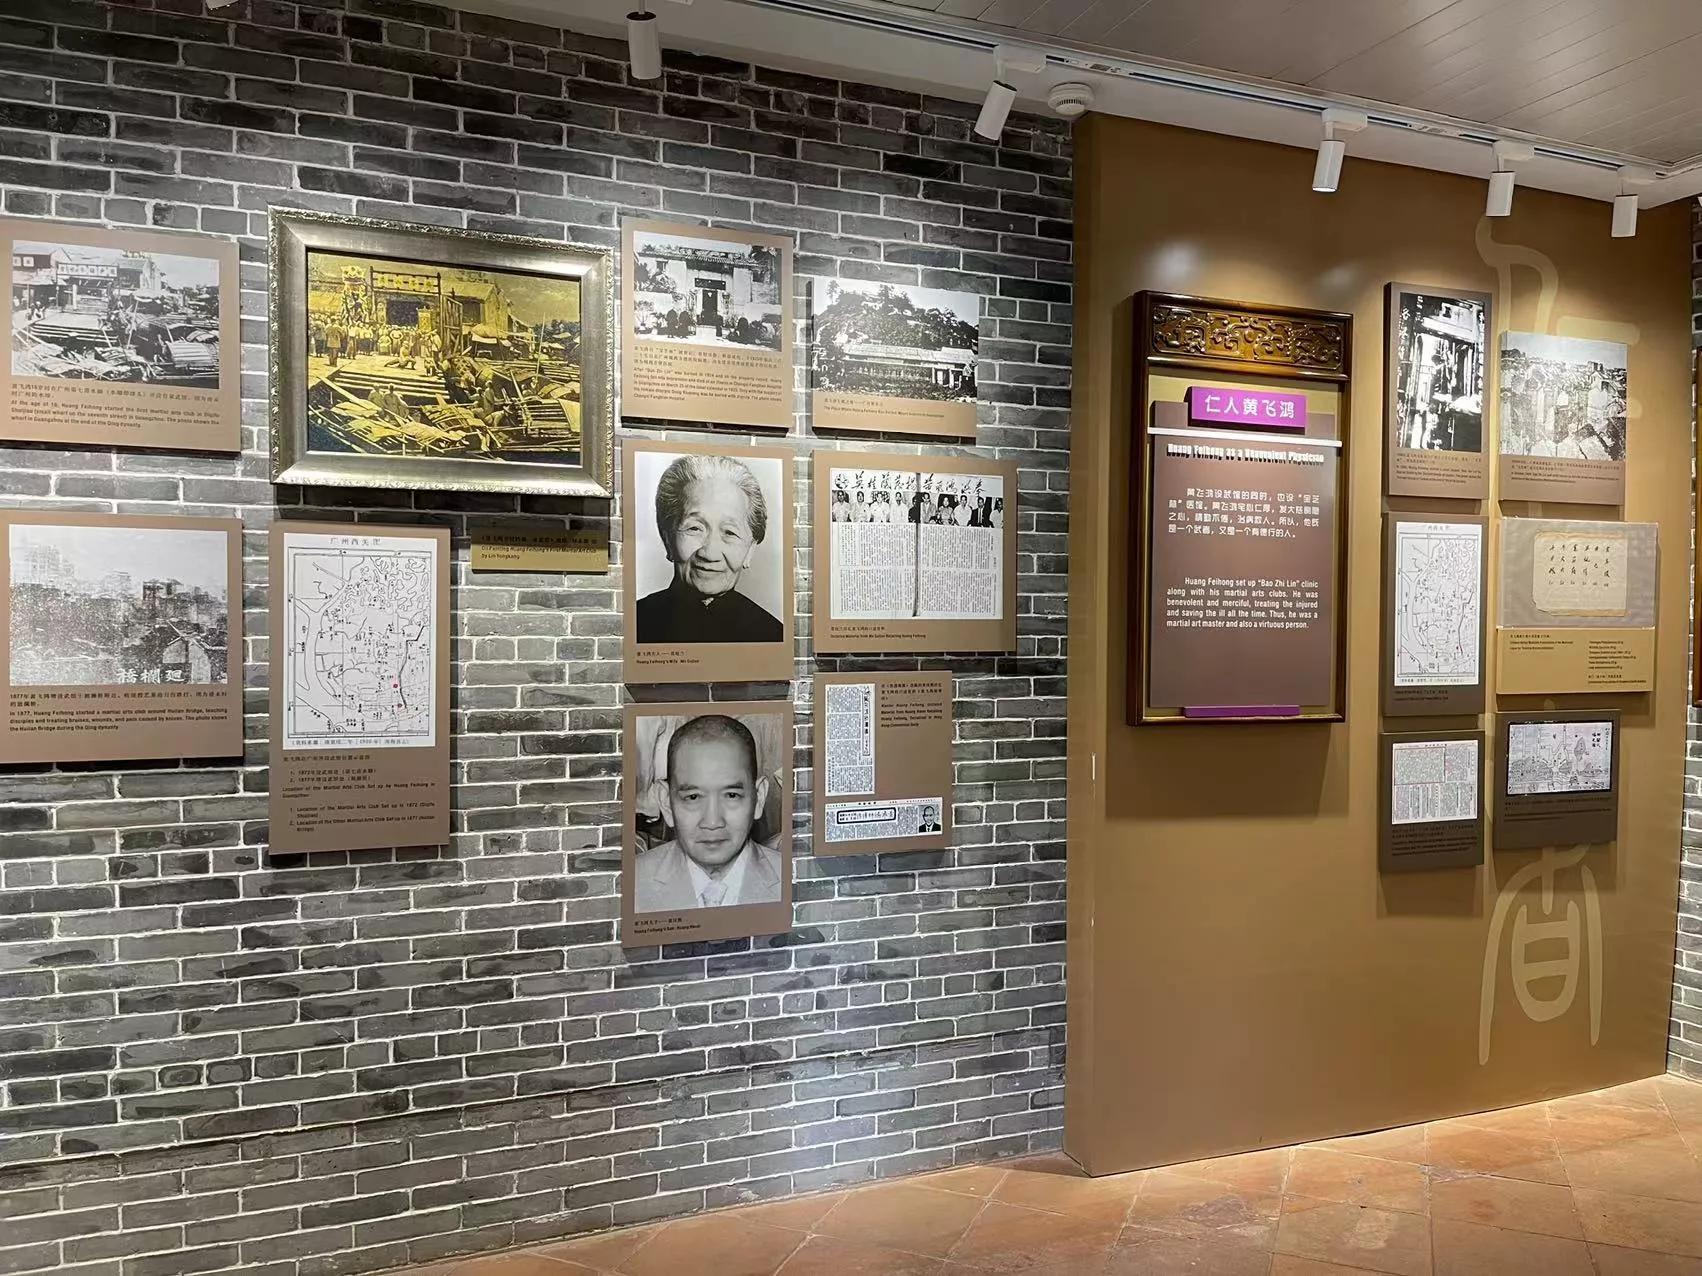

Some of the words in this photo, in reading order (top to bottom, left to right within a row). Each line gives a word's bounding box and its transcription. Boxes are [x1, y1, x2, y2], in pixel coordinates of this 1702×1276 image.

[1205, 395, 1296, 418] 仁人黄飞鸿
[1168, 444, 1191, 455] Huang
[1195, 445, 1224, 457] Feihong
[1245, 449, 1286, 460] Benevolent
[1289, 452, 1324, 464] Physician
[1185, 577, 1206, 586] Huang
[1208, 578, 1234, 587] Feihong
[1167, 588, 1185, 597] along
[1223, 600, 1252, 609] merciful,
[1254, 600, 1279, 609] treating
[1296, 601, 1318, 610] injured
[1182, 610, 1203, 618] saving
[1270, 611, 1287, 619] Thus,
